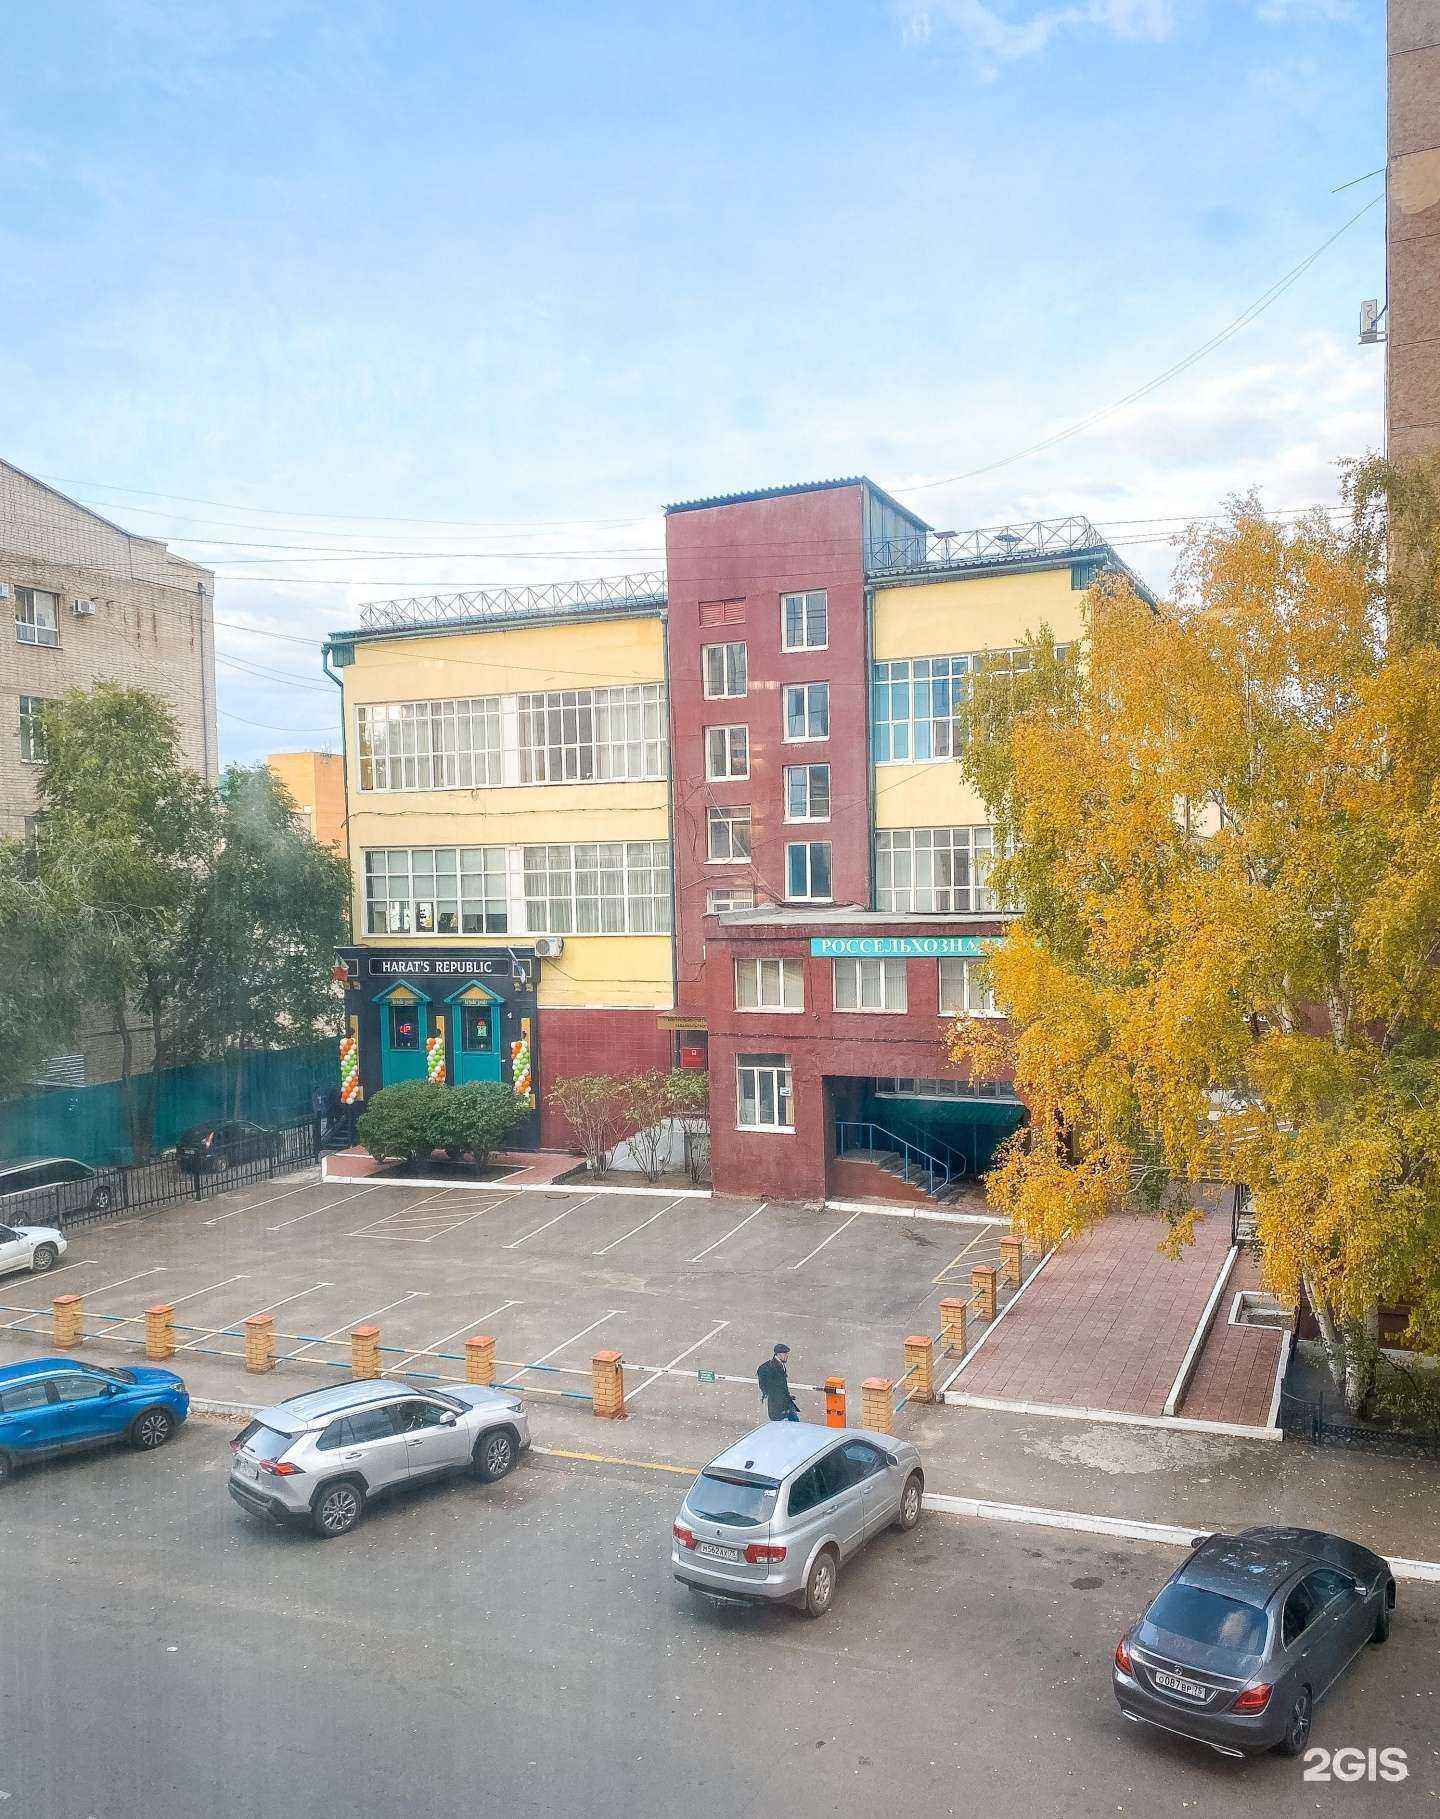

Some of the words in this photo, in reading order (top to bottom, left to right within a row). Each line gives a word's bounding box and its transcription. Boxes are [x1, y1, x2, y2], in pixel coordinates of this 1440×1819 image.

[821, 938, 1004, 953] РОССЕЛЬХОЗНА
[382, 961, 430, 973] HARAT'S
[435, 961, 493, 973] REPUBLIC
